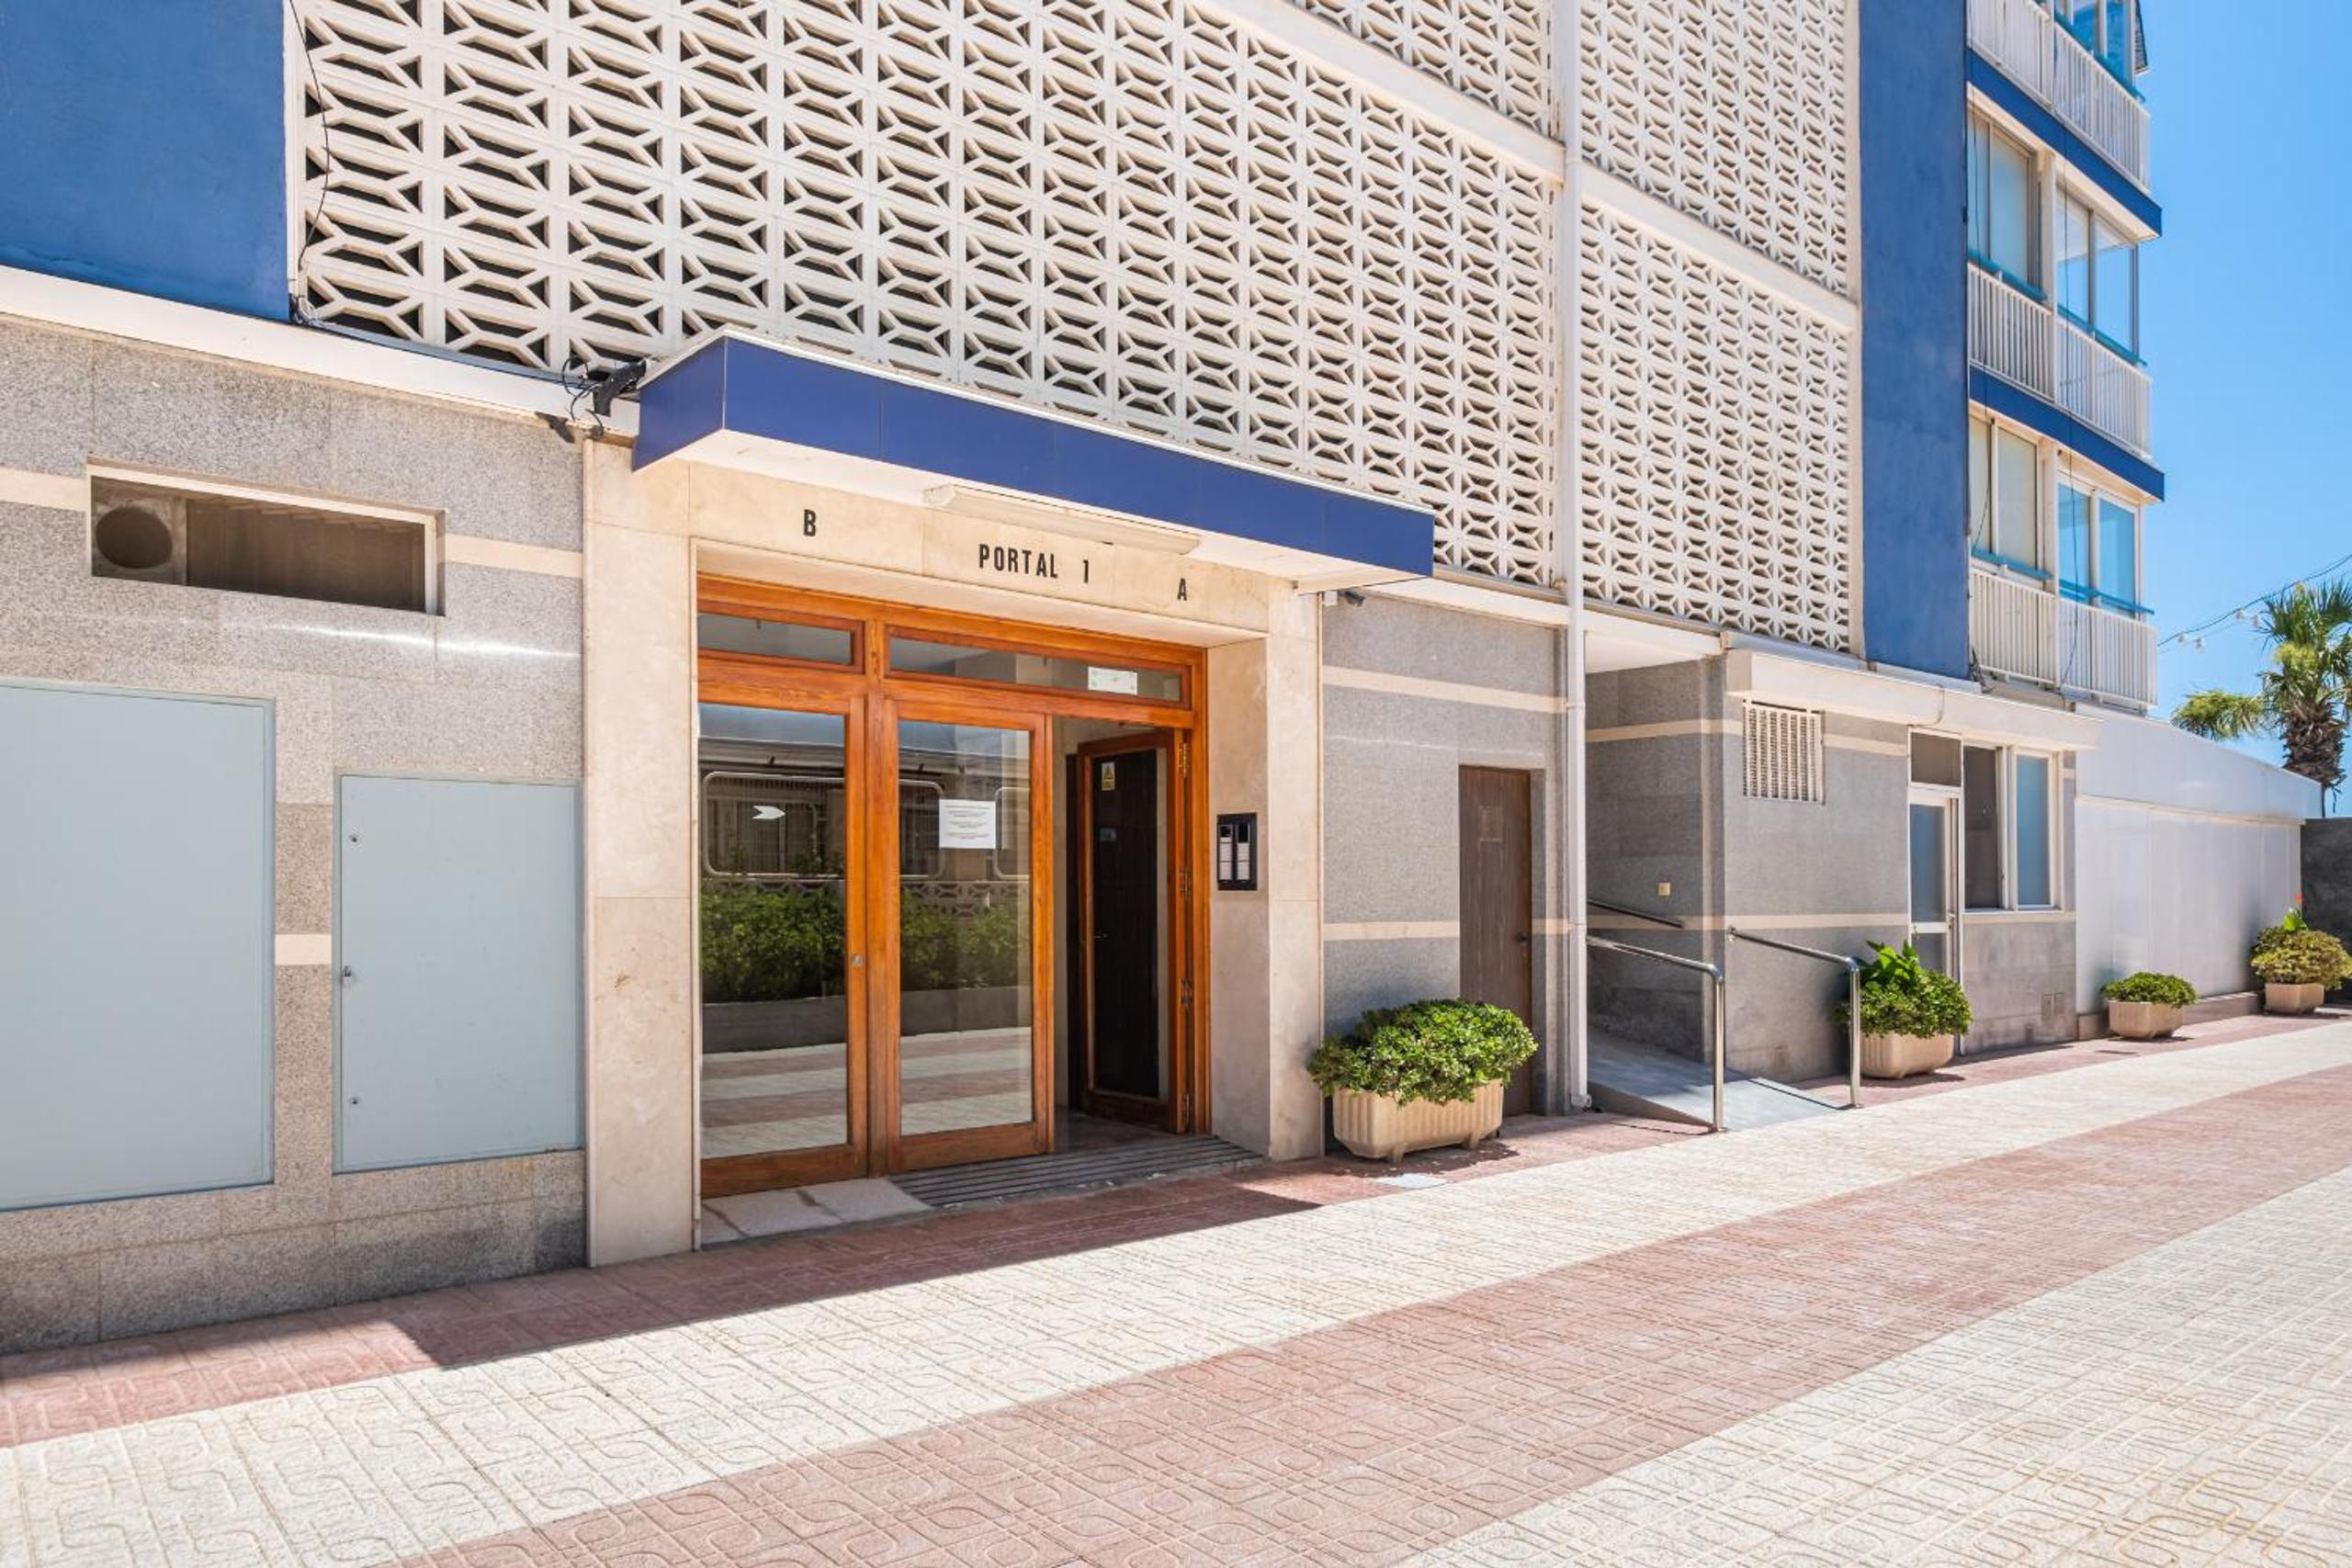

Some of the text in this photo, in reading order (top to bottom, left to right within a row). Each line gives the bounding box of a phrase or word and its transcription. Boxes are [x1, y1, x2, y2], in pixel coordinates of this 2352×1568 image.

[803, 509, 816, 537] B
[978, 544, 1090, 583] PORTAL 1
[1177, 578, 1188, 601] A
